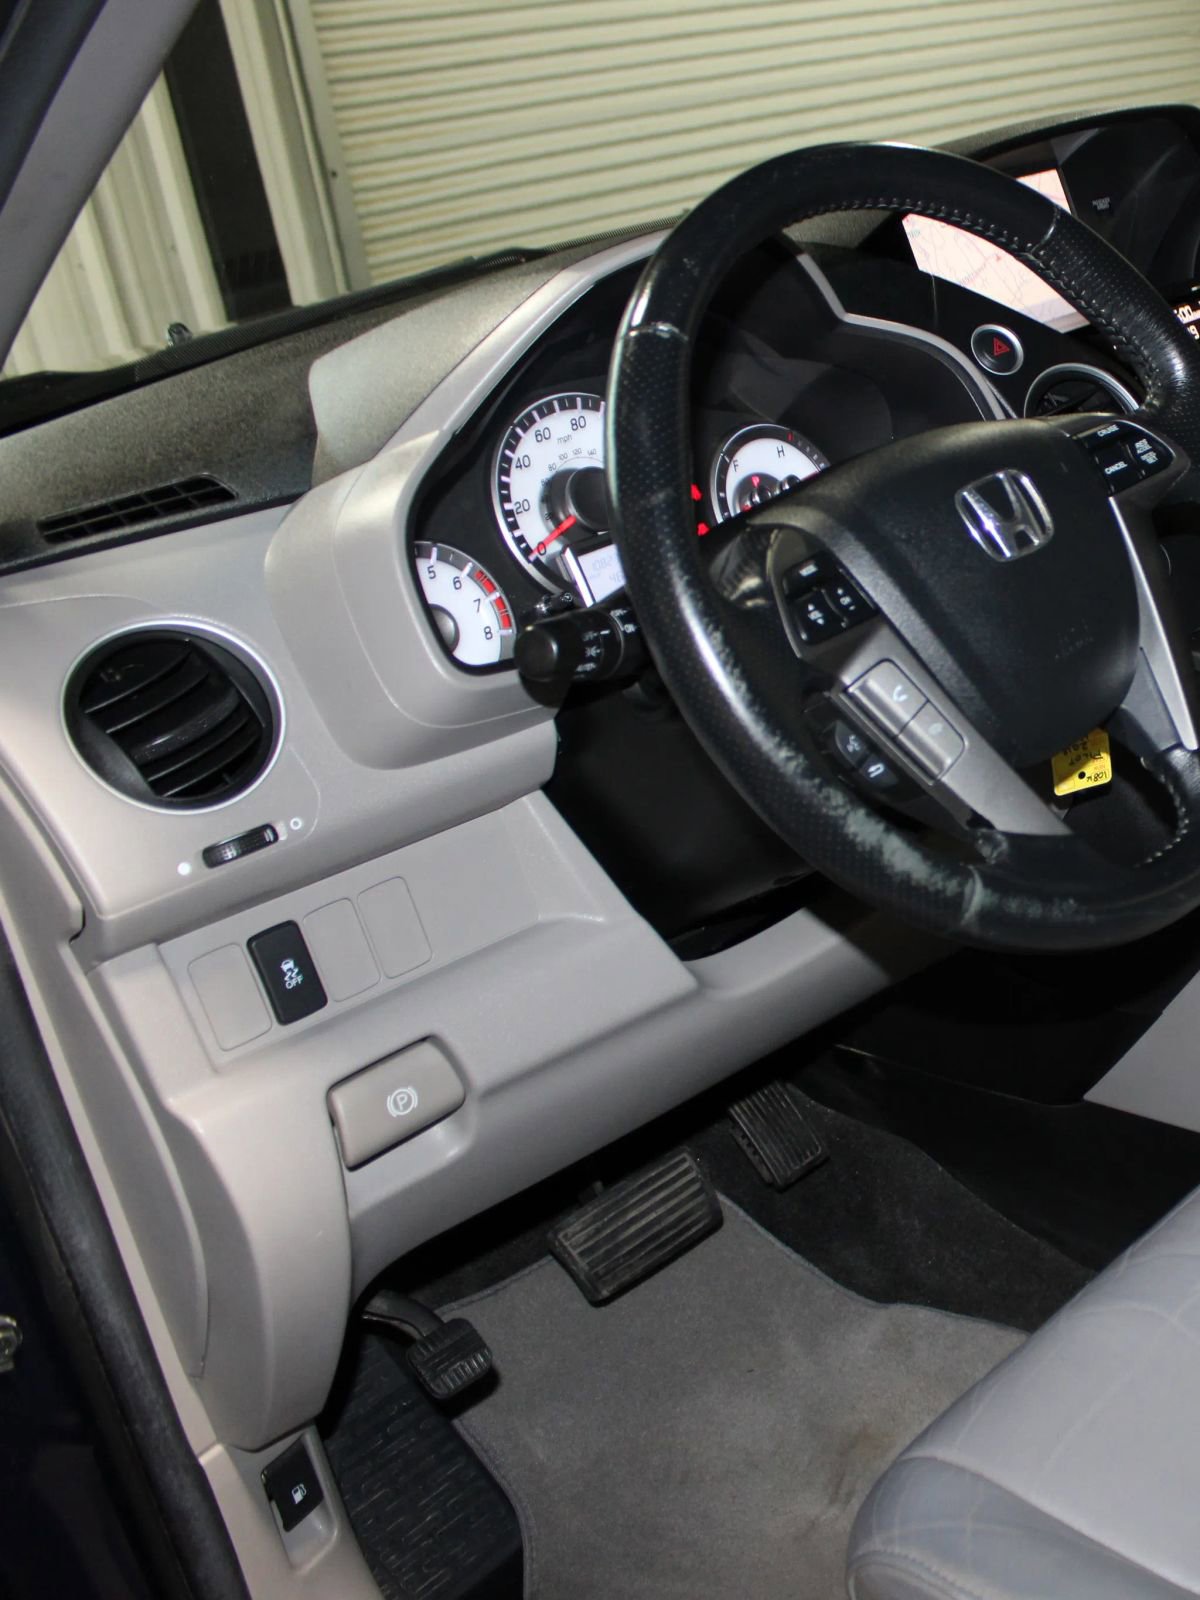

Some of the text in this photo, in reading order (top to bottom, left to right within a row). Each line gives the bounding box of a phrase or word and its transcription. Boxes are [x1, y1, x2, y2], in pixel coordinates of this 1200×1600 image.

[569, 415, 587, 431] 80
[534, 427, 552, 443] 60
[557, 433, 573, 446] mph
[775, 444, 786, 459] H
[514, 454, 531, 470] 40
[732, 459, 740, 473] F
[1104, 461, 1128, 475] CANCEL
[514, 498, 530, 515] 20
[536, 541, 547, 556] 0
[427, 565, 436, 579] 5
[452, 576, 462, 590] 6
[473, 598, 481, 613] 7
[483, 626, 493, 640] 8
[285, 974, 304, 990] OFF
